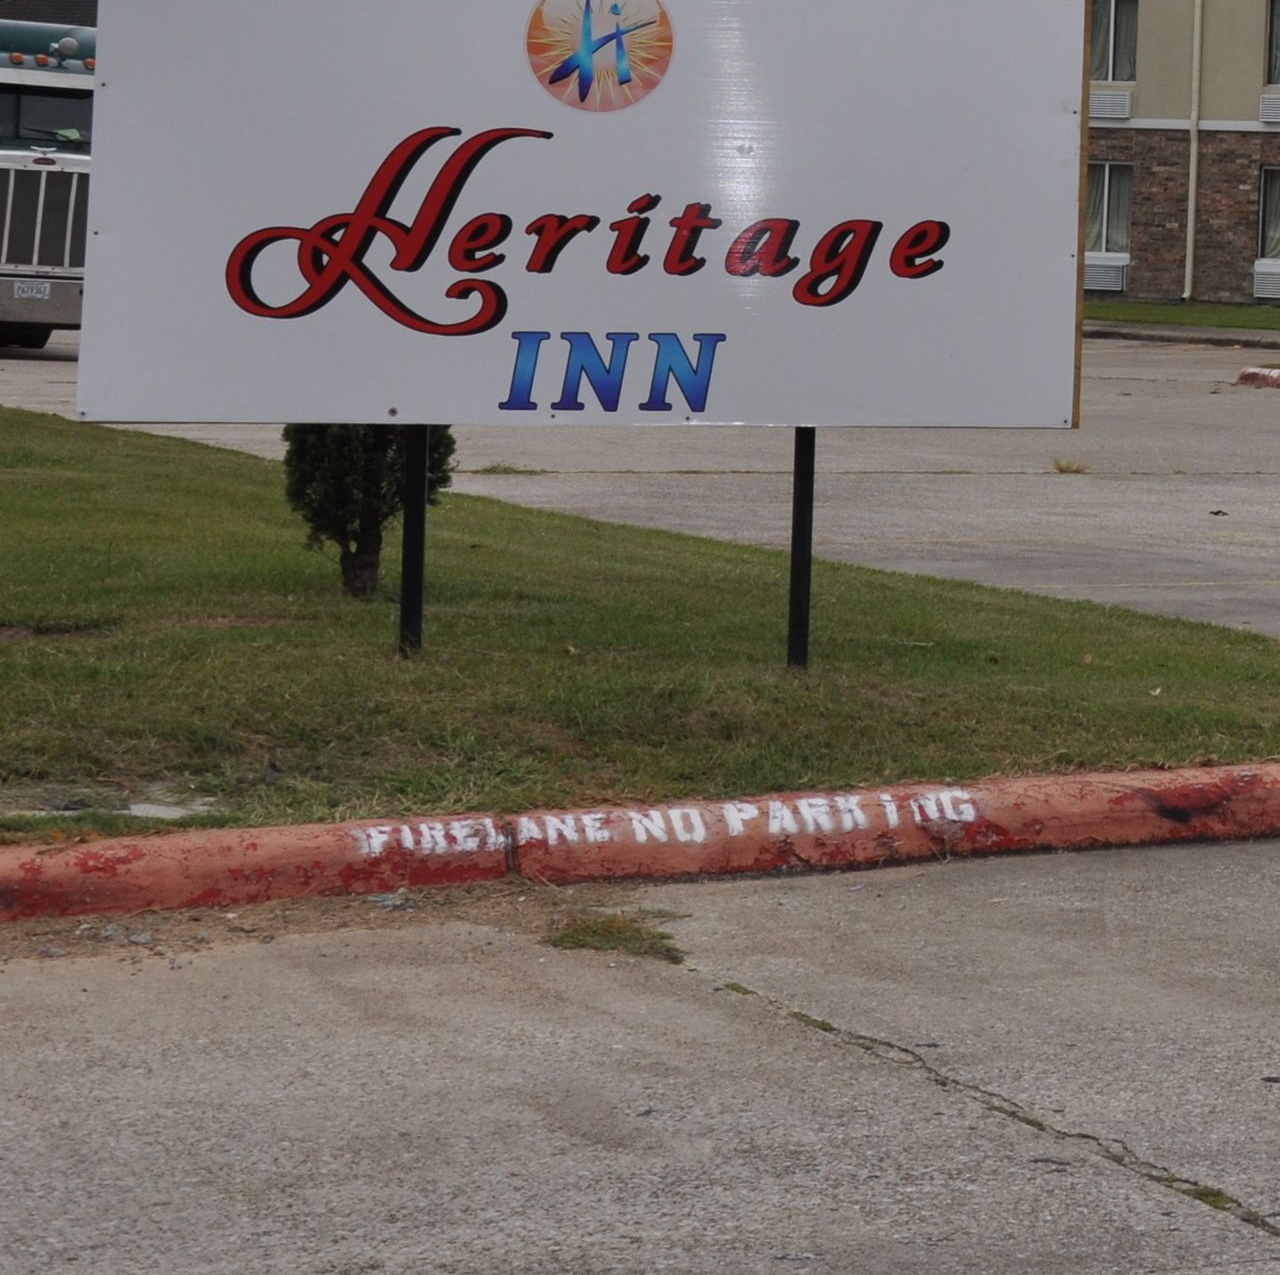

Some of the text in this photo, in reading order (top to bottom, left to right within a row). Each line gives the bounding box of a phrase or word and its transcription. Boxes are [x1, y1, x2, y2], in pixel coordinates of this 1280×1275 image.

[226, 126, 951, 336] Heritage
[498, 330, 727, 413] INN
[631, 807, 706, 845] NO
[723, 790, 977, 838] PARKING
